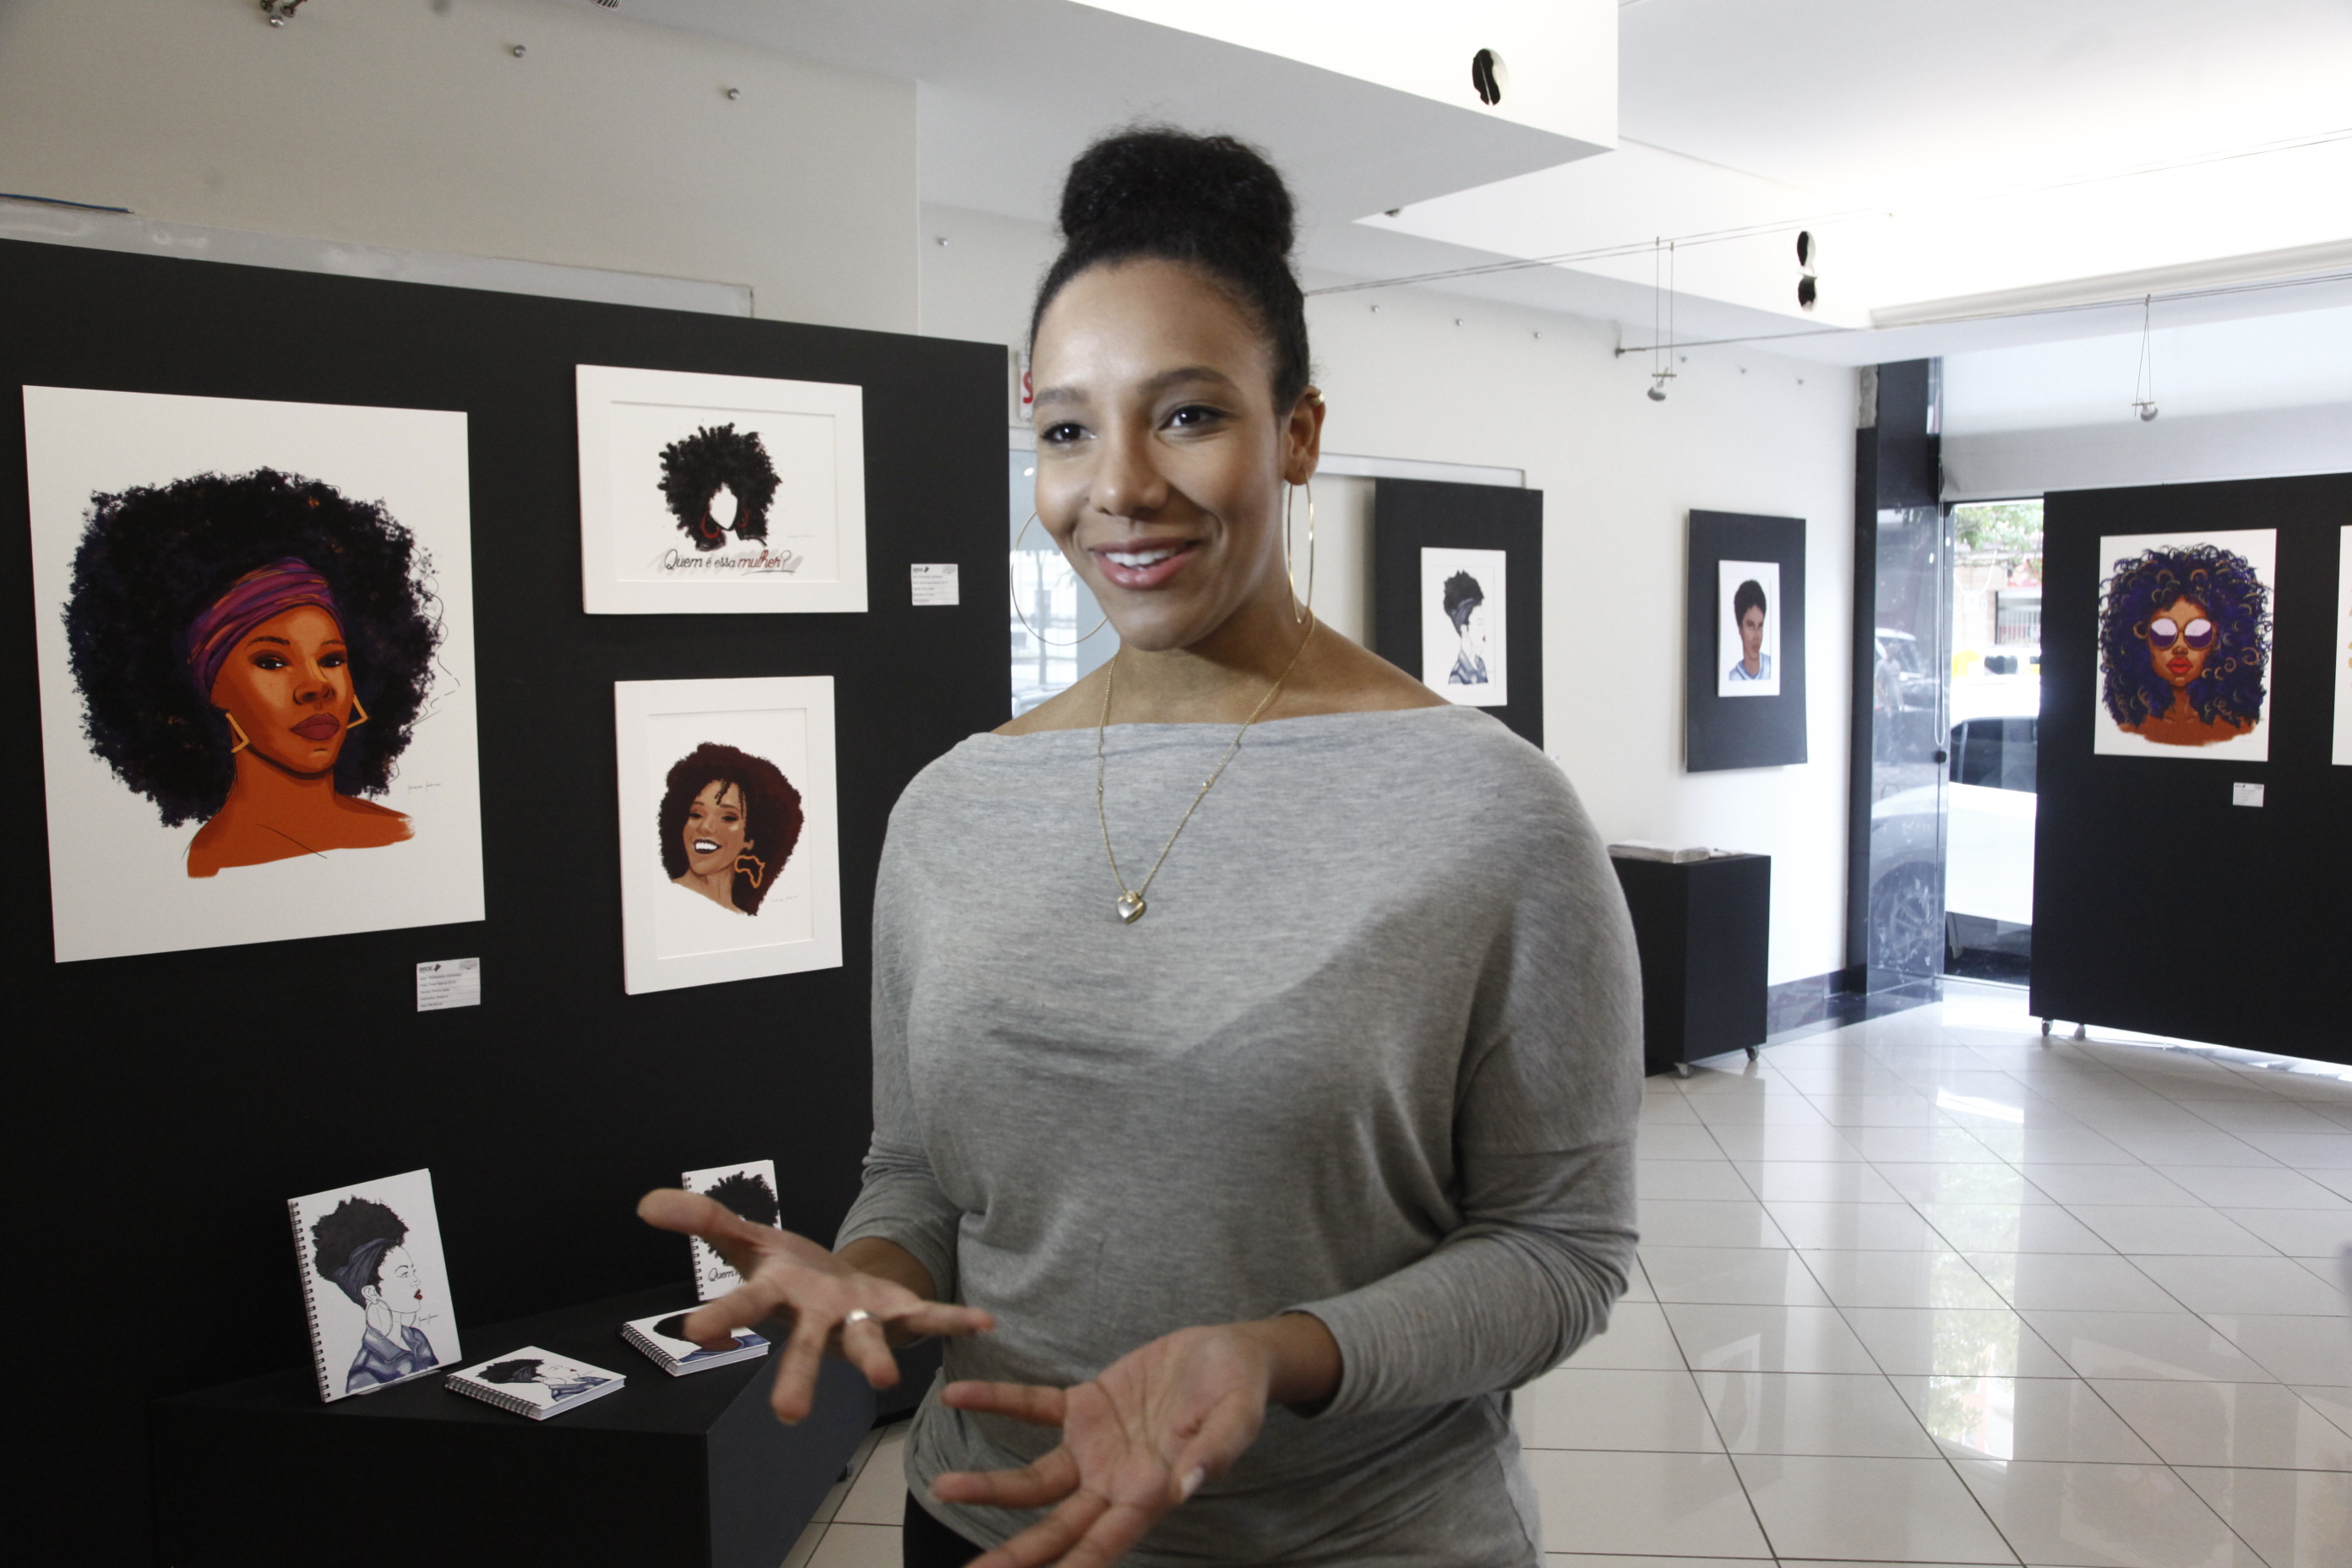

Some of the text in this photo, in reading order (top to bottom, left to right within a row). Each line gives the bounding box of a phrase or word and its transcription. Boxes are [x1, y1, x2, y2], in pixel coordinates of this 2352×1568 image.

[664, 548, 792, 570] Quem é essa mulher?
[709, 1267, 734, 1282] Quem
